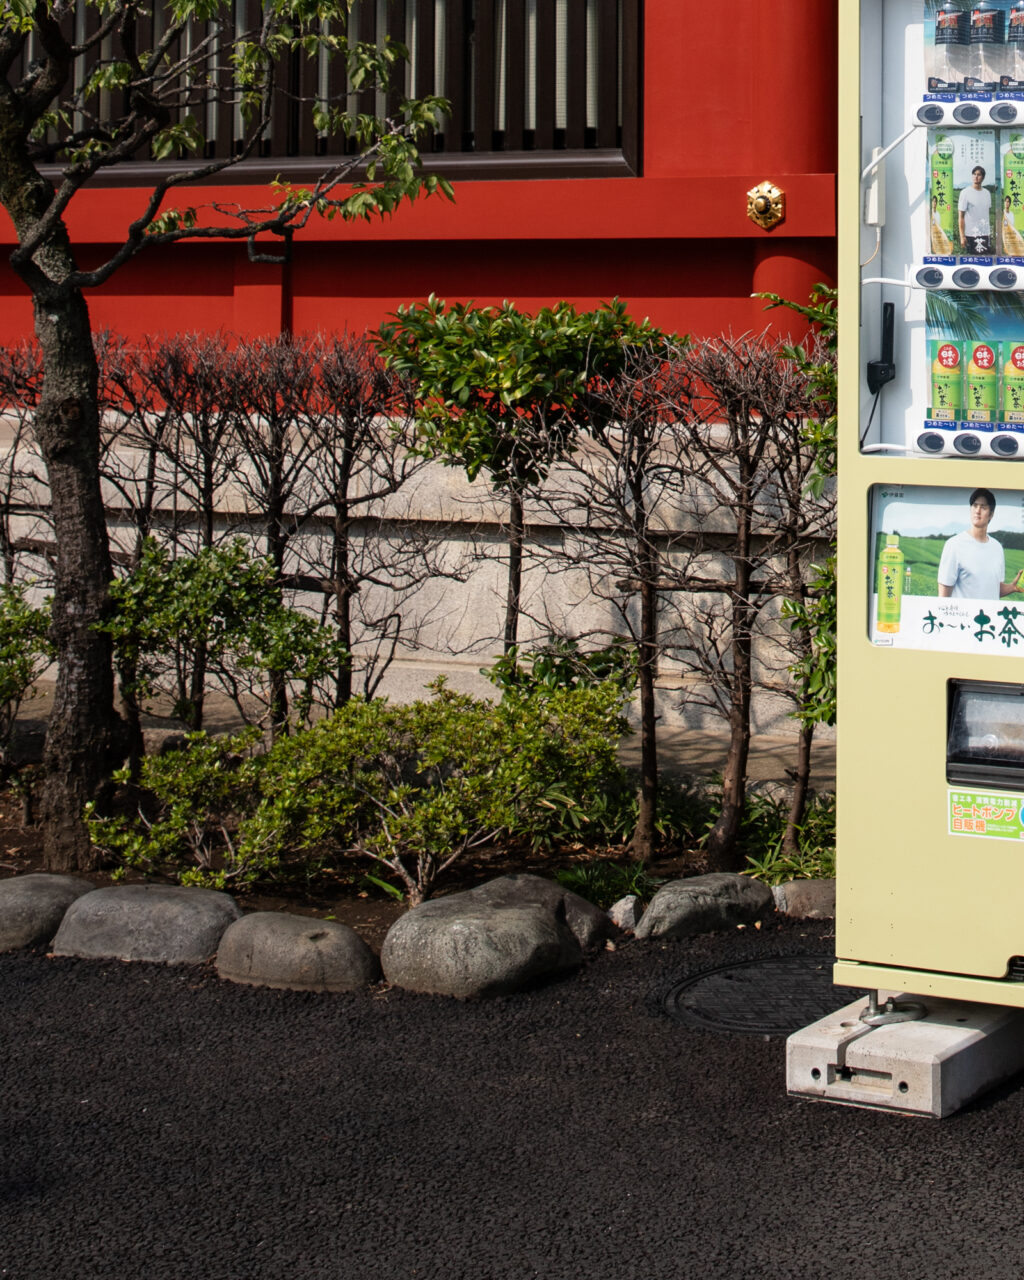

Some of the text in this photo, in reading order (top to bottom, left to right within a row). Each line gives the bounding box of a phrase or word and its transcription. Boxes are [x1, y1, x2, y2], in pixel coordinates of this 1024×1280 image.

[952, 804, 1016, 821] ヒートポンプ
[953, 818, 986, 832] 自販機
